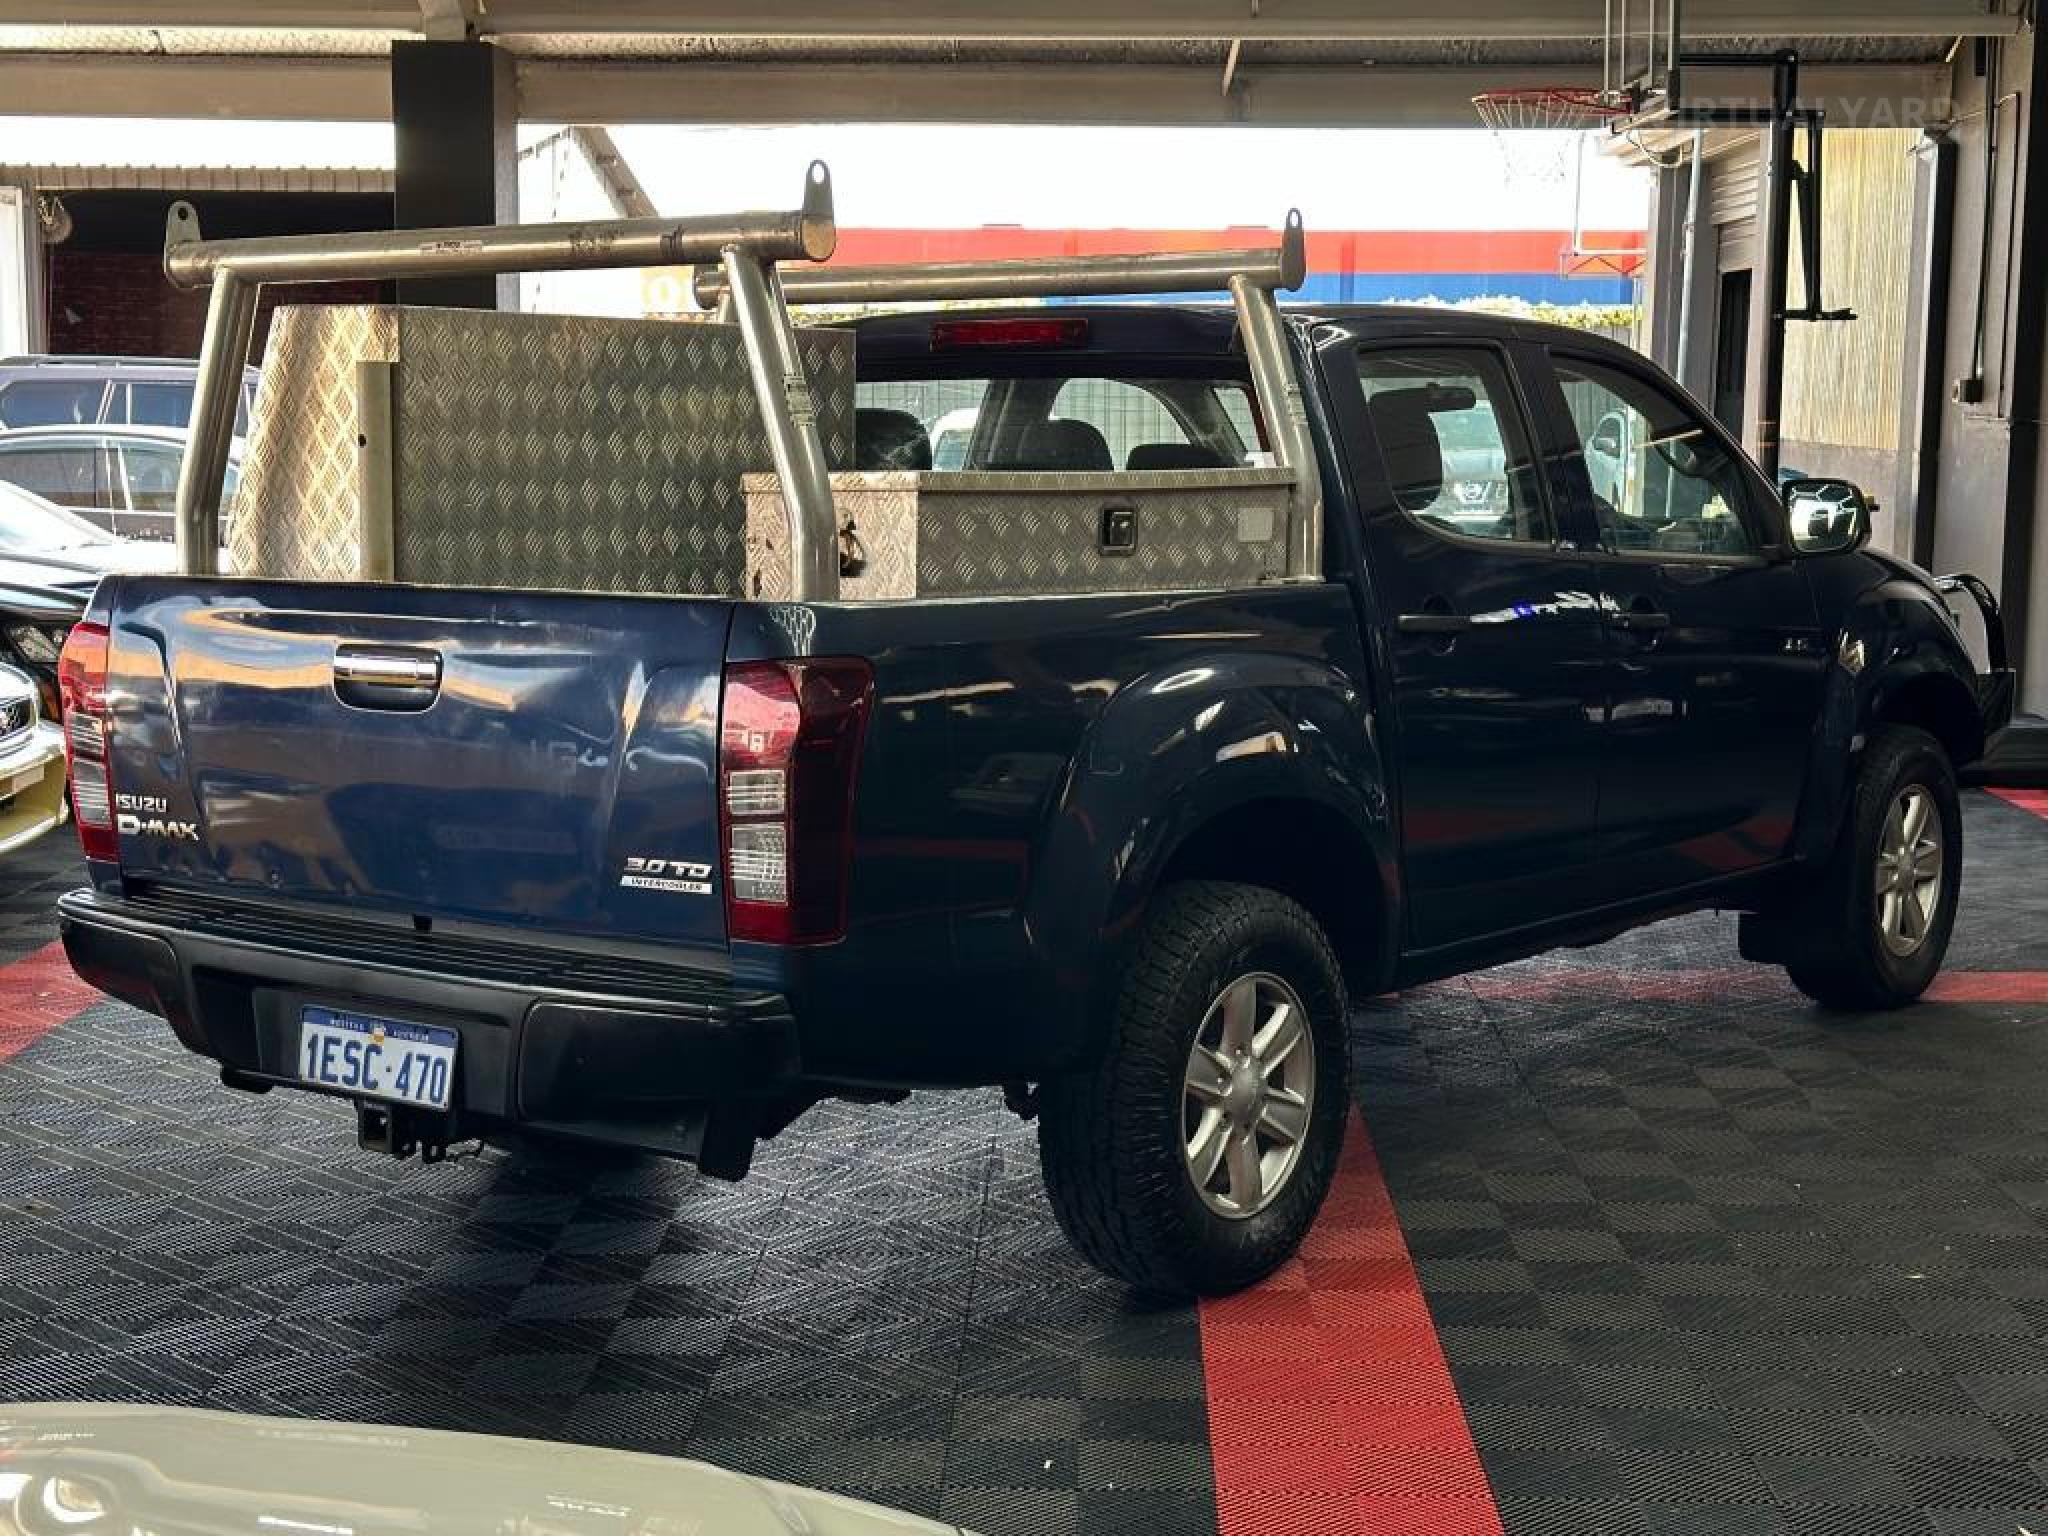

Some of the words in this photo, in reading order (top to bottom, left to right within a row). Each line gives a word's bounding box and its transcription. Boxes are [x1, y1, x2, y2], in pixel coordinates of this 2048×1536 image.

[115, 793, 167, 812] ISUZU
[116, 813, 199, 841] D-MAX
[669, 861, 712, 878] TD
